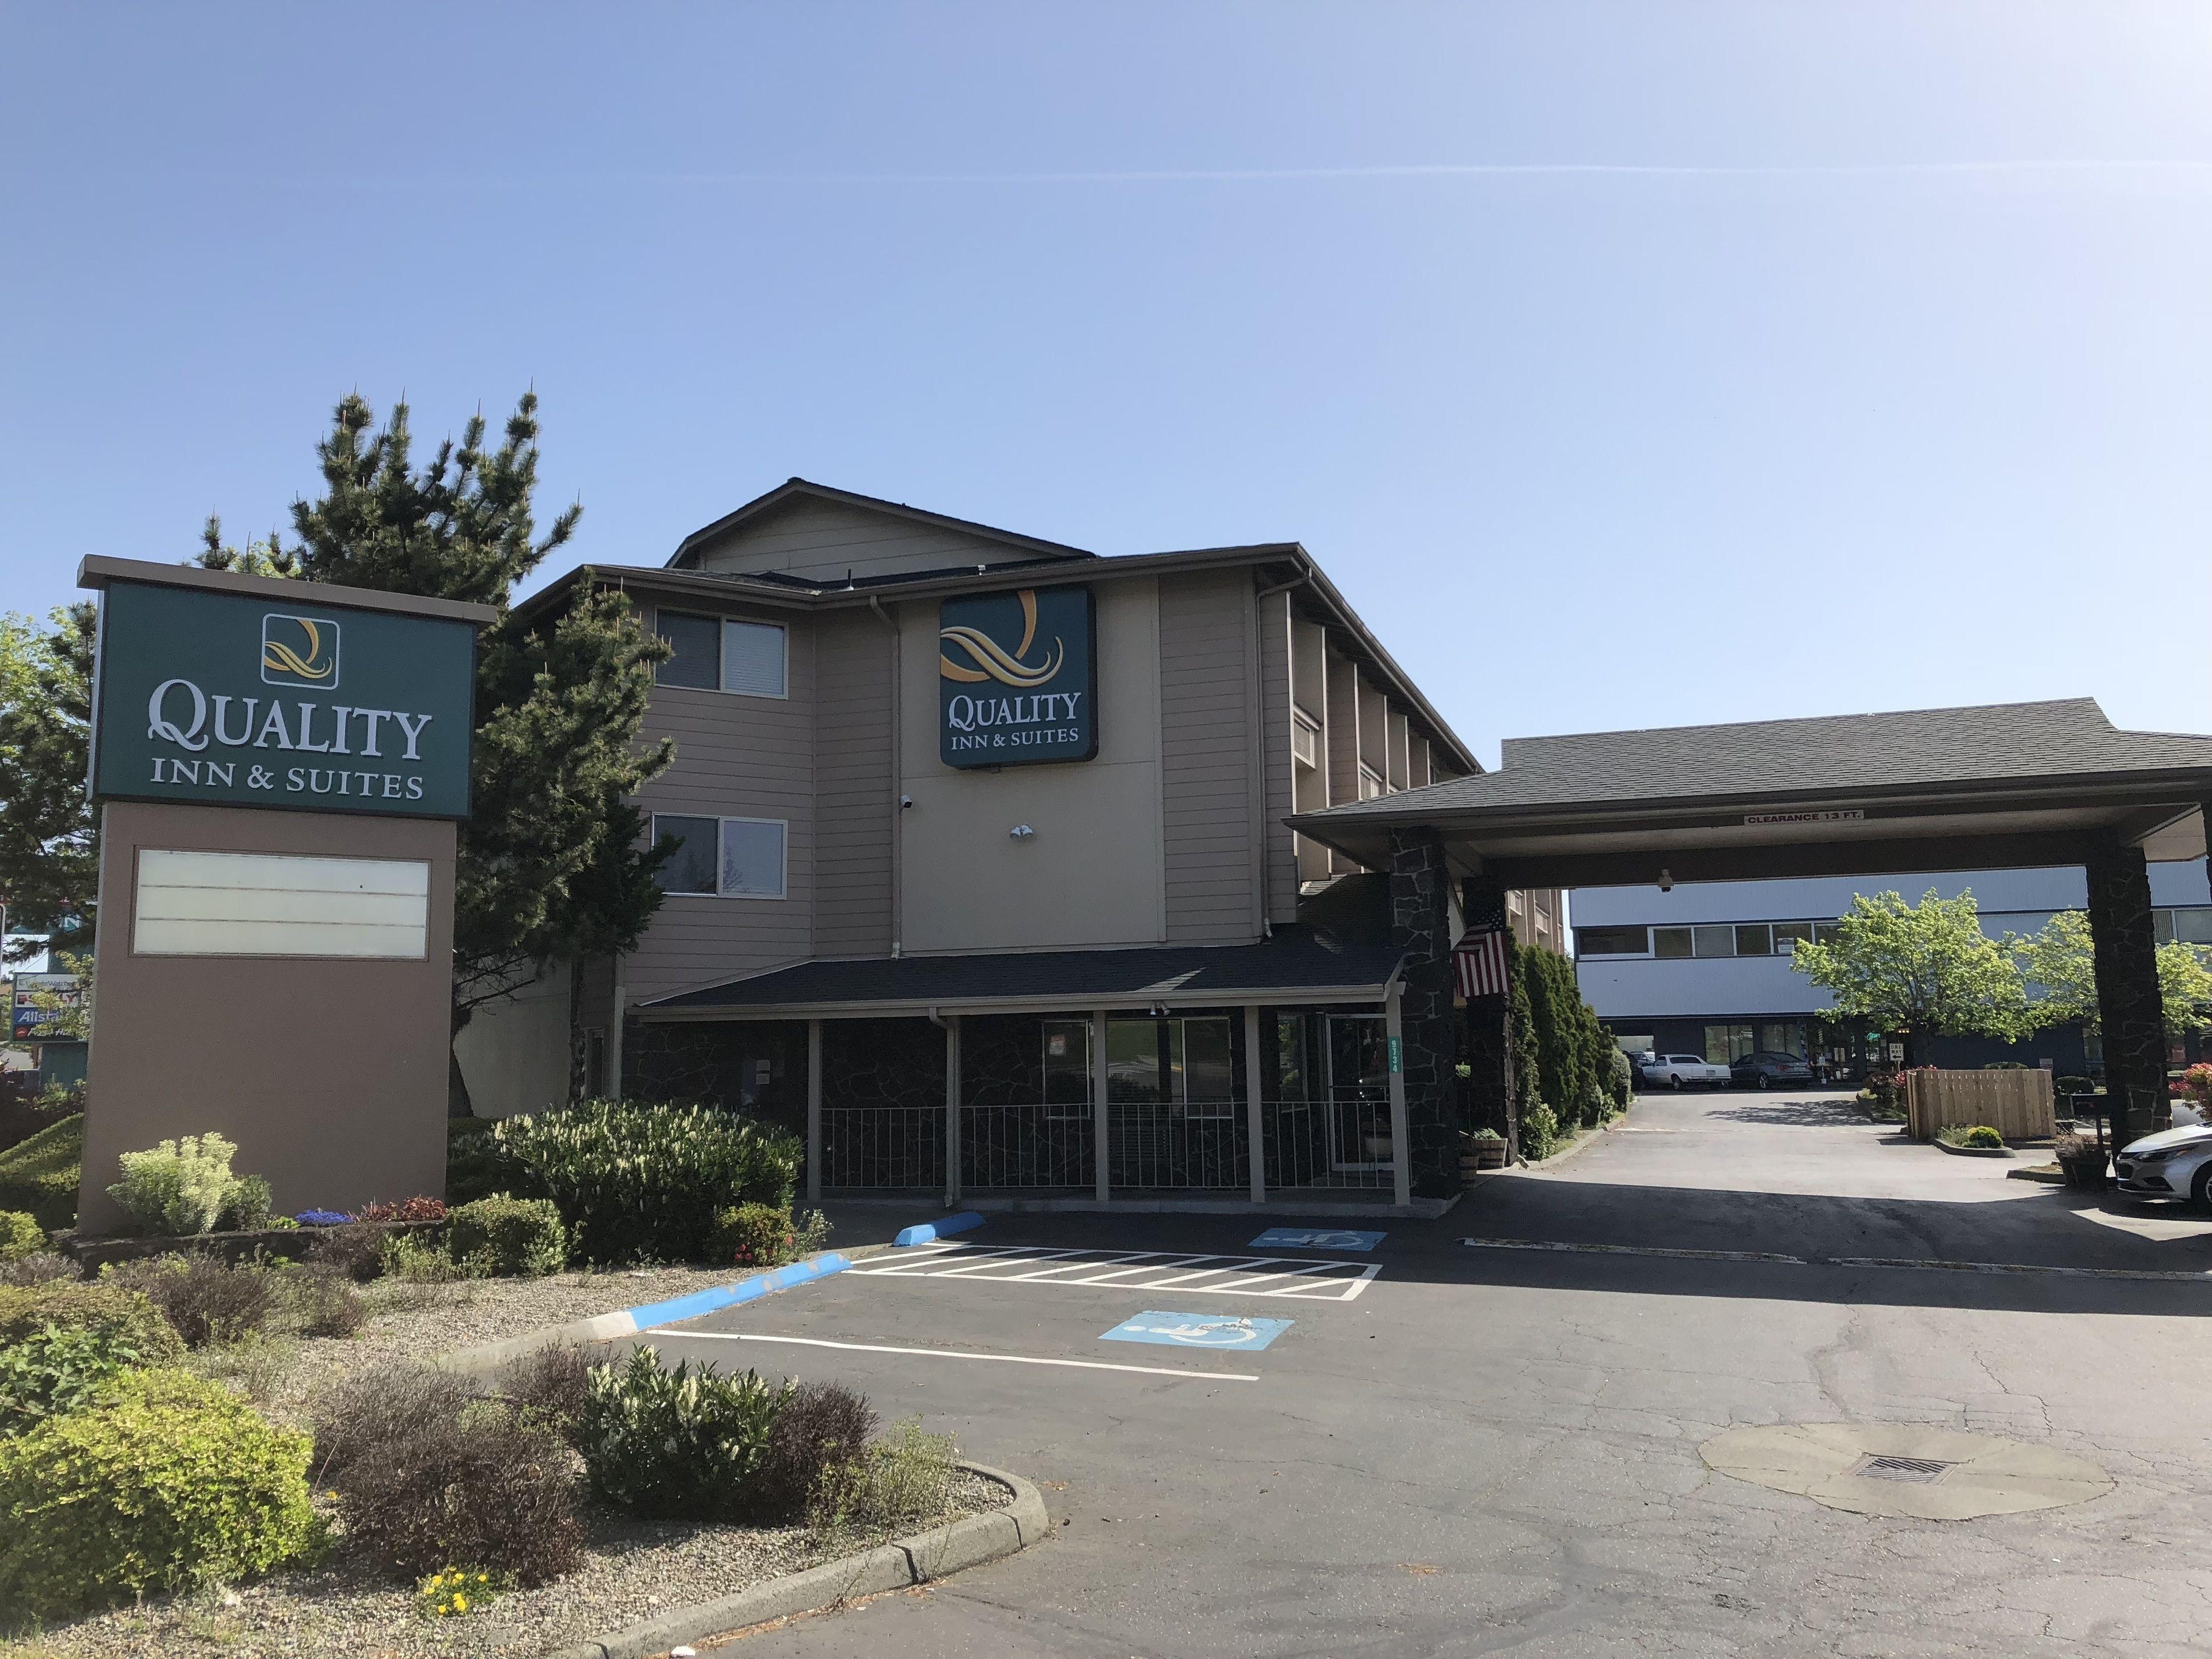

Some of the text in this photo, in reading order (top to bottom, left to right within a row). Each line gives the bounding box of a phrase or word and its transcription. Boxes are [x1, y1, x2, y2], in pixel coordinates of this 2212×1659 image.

[148, 679, 432, 760] QUALITY
[949, 692, 1081, 732] QUALITY
[951, 728, 1078, 750] INN & SUITES
[150, 757, 422, 800] INN & SUITES
[1748, 813, 1819, 824] CLEARANCE
